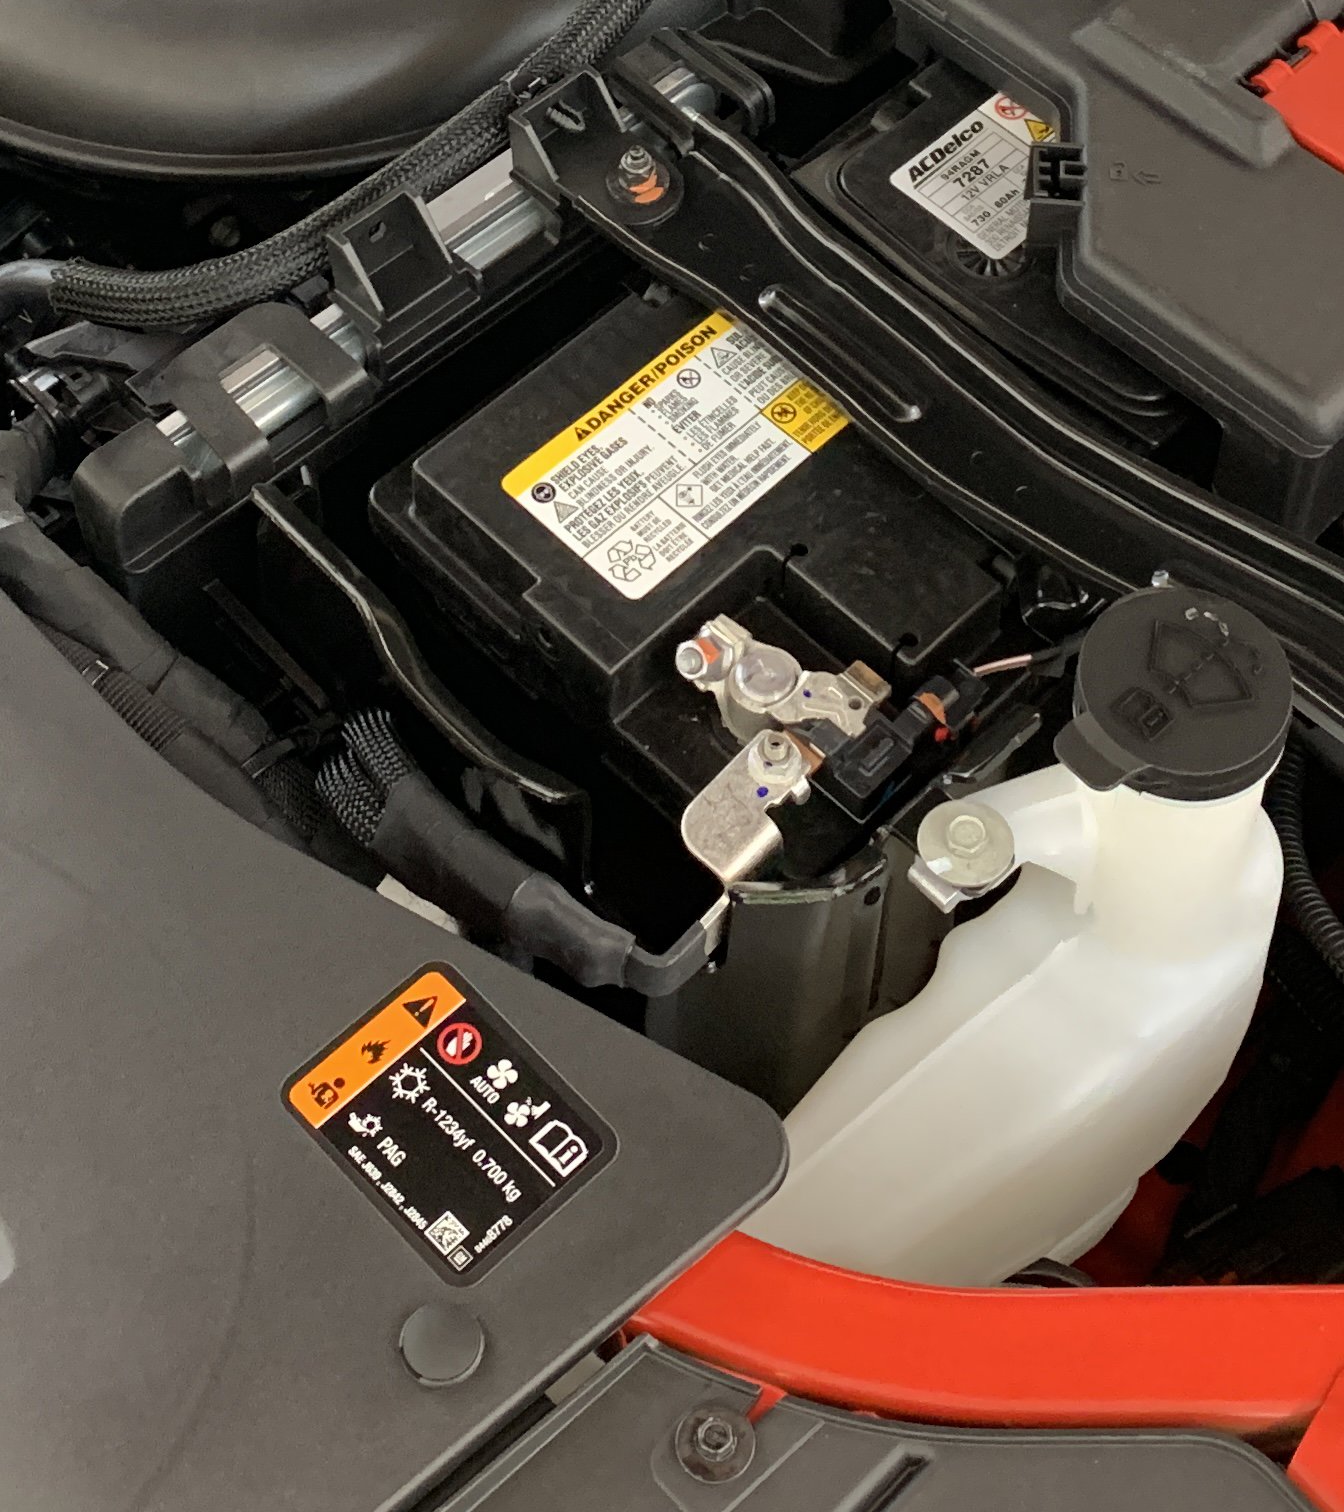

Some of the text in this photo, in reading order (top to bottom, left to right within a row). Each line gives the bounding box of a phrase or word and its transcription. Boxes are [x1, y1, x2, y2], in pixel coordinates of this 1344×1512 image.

[907, 121, 984, 184] ACDelco
[951, 157, 991, 189] 7287
[961, 185, 981, 201] 12V
[978, 162, 1009, 188] VRLA
[587, 326, 717, 430] DANGER/POISON
[720, 355, 746, 376] CAUSE
[641, 396, 656, 409] NO
[659, 393, 688, 417] FLAMES
[685, 424, 702, 438] LES
[692, 405, 740, 444] LES FLAMMES
[700, 421, 736, 450] DE FUMER
[549, 459, 581, 485] SHIELD
[558, 435, 628, 492] EXPLOSIVE GASES
[567, 465, 609, 500] CAN CAUSE
[572, 455, 678, 541] LES GAZ EXPLOSIFS PEUVENT
[575, 472, 617, 507] BLINDNESS
[613, 464, 628, 476] OR
[602, 486, 621, 502] LES
[581, 520, 616, 548] BLESSER
[612, 511, 627, 523] OU
[622, 488, 655, 514] RENDRE
[468, 1073, 501, 1105] AUTO
[347, 1144, 367, 1164] SAE
[375, 1135, 408, 1168] PAG
[420, 1097, 524, 1204] R-1234yf 0.700 kg
